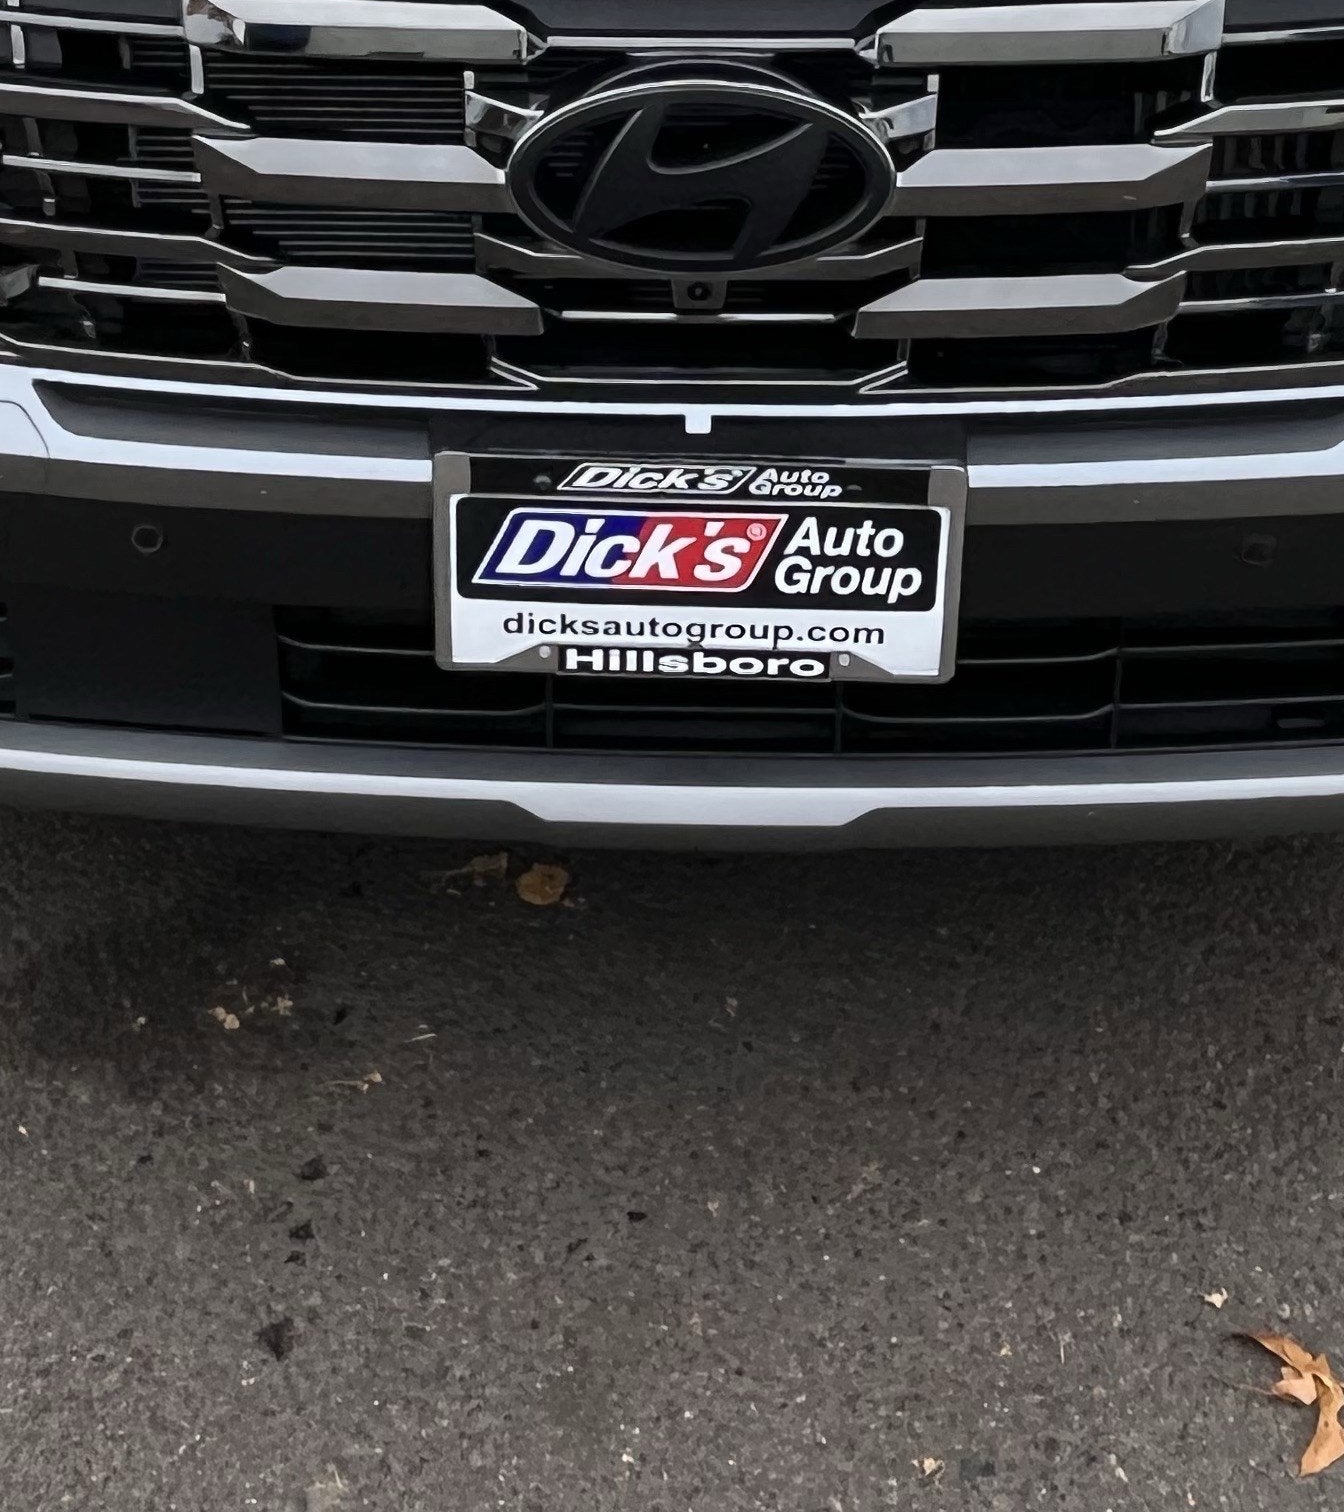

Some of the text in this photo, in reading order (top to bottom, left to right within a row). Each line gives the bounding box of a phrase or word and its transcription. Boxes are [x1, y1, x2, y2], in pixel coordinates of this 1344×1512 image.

[573, 465, 736, 492] Dick's
[748, 481, 843, 499] Group
[754, 468, 831, 485] Auto
[495, 517, 750, 583] Dick's
[784, 516, 905, 558] Auto
[774, 557, 923, 604] Group
[502, 612, 886, 649] dicksautogroup.com
[564, 648, 825, 677] Hillsboro
